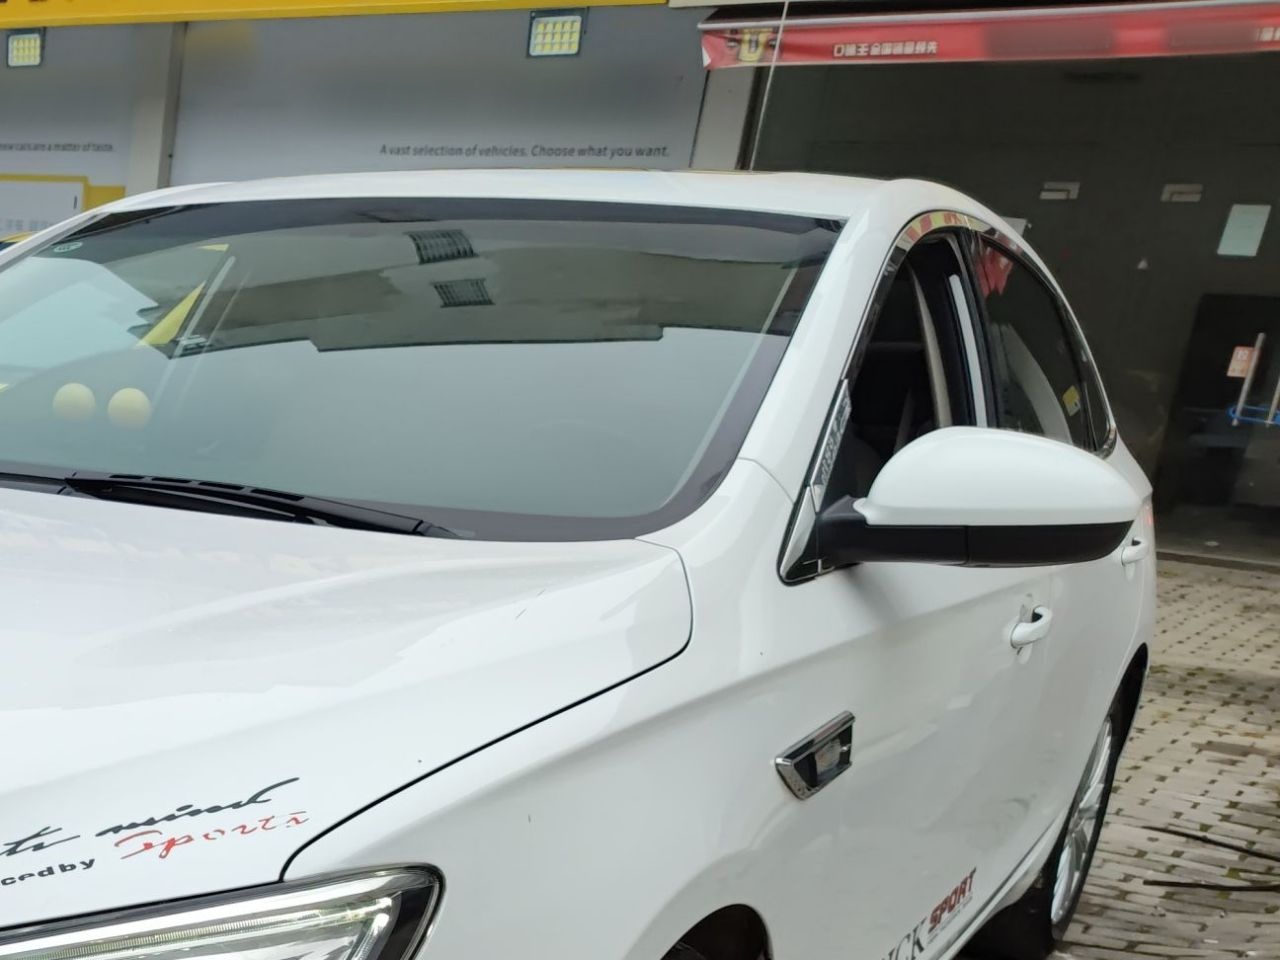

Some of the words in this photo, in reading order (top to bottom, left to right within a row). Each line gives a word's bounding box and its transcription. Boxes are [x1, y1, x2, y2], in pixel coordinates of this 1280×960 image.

[379, 144, 388, 155] A
[389, 145, 411, 156] vast
[412, 144, 463, 156] selection
[464, 144, 478, 157] of
[531, 144, 576, 157] Choose
[577, 145, 607, 157] what
[607, 147, 632, 160] you
[928, 866, 977, 934] SPORT
